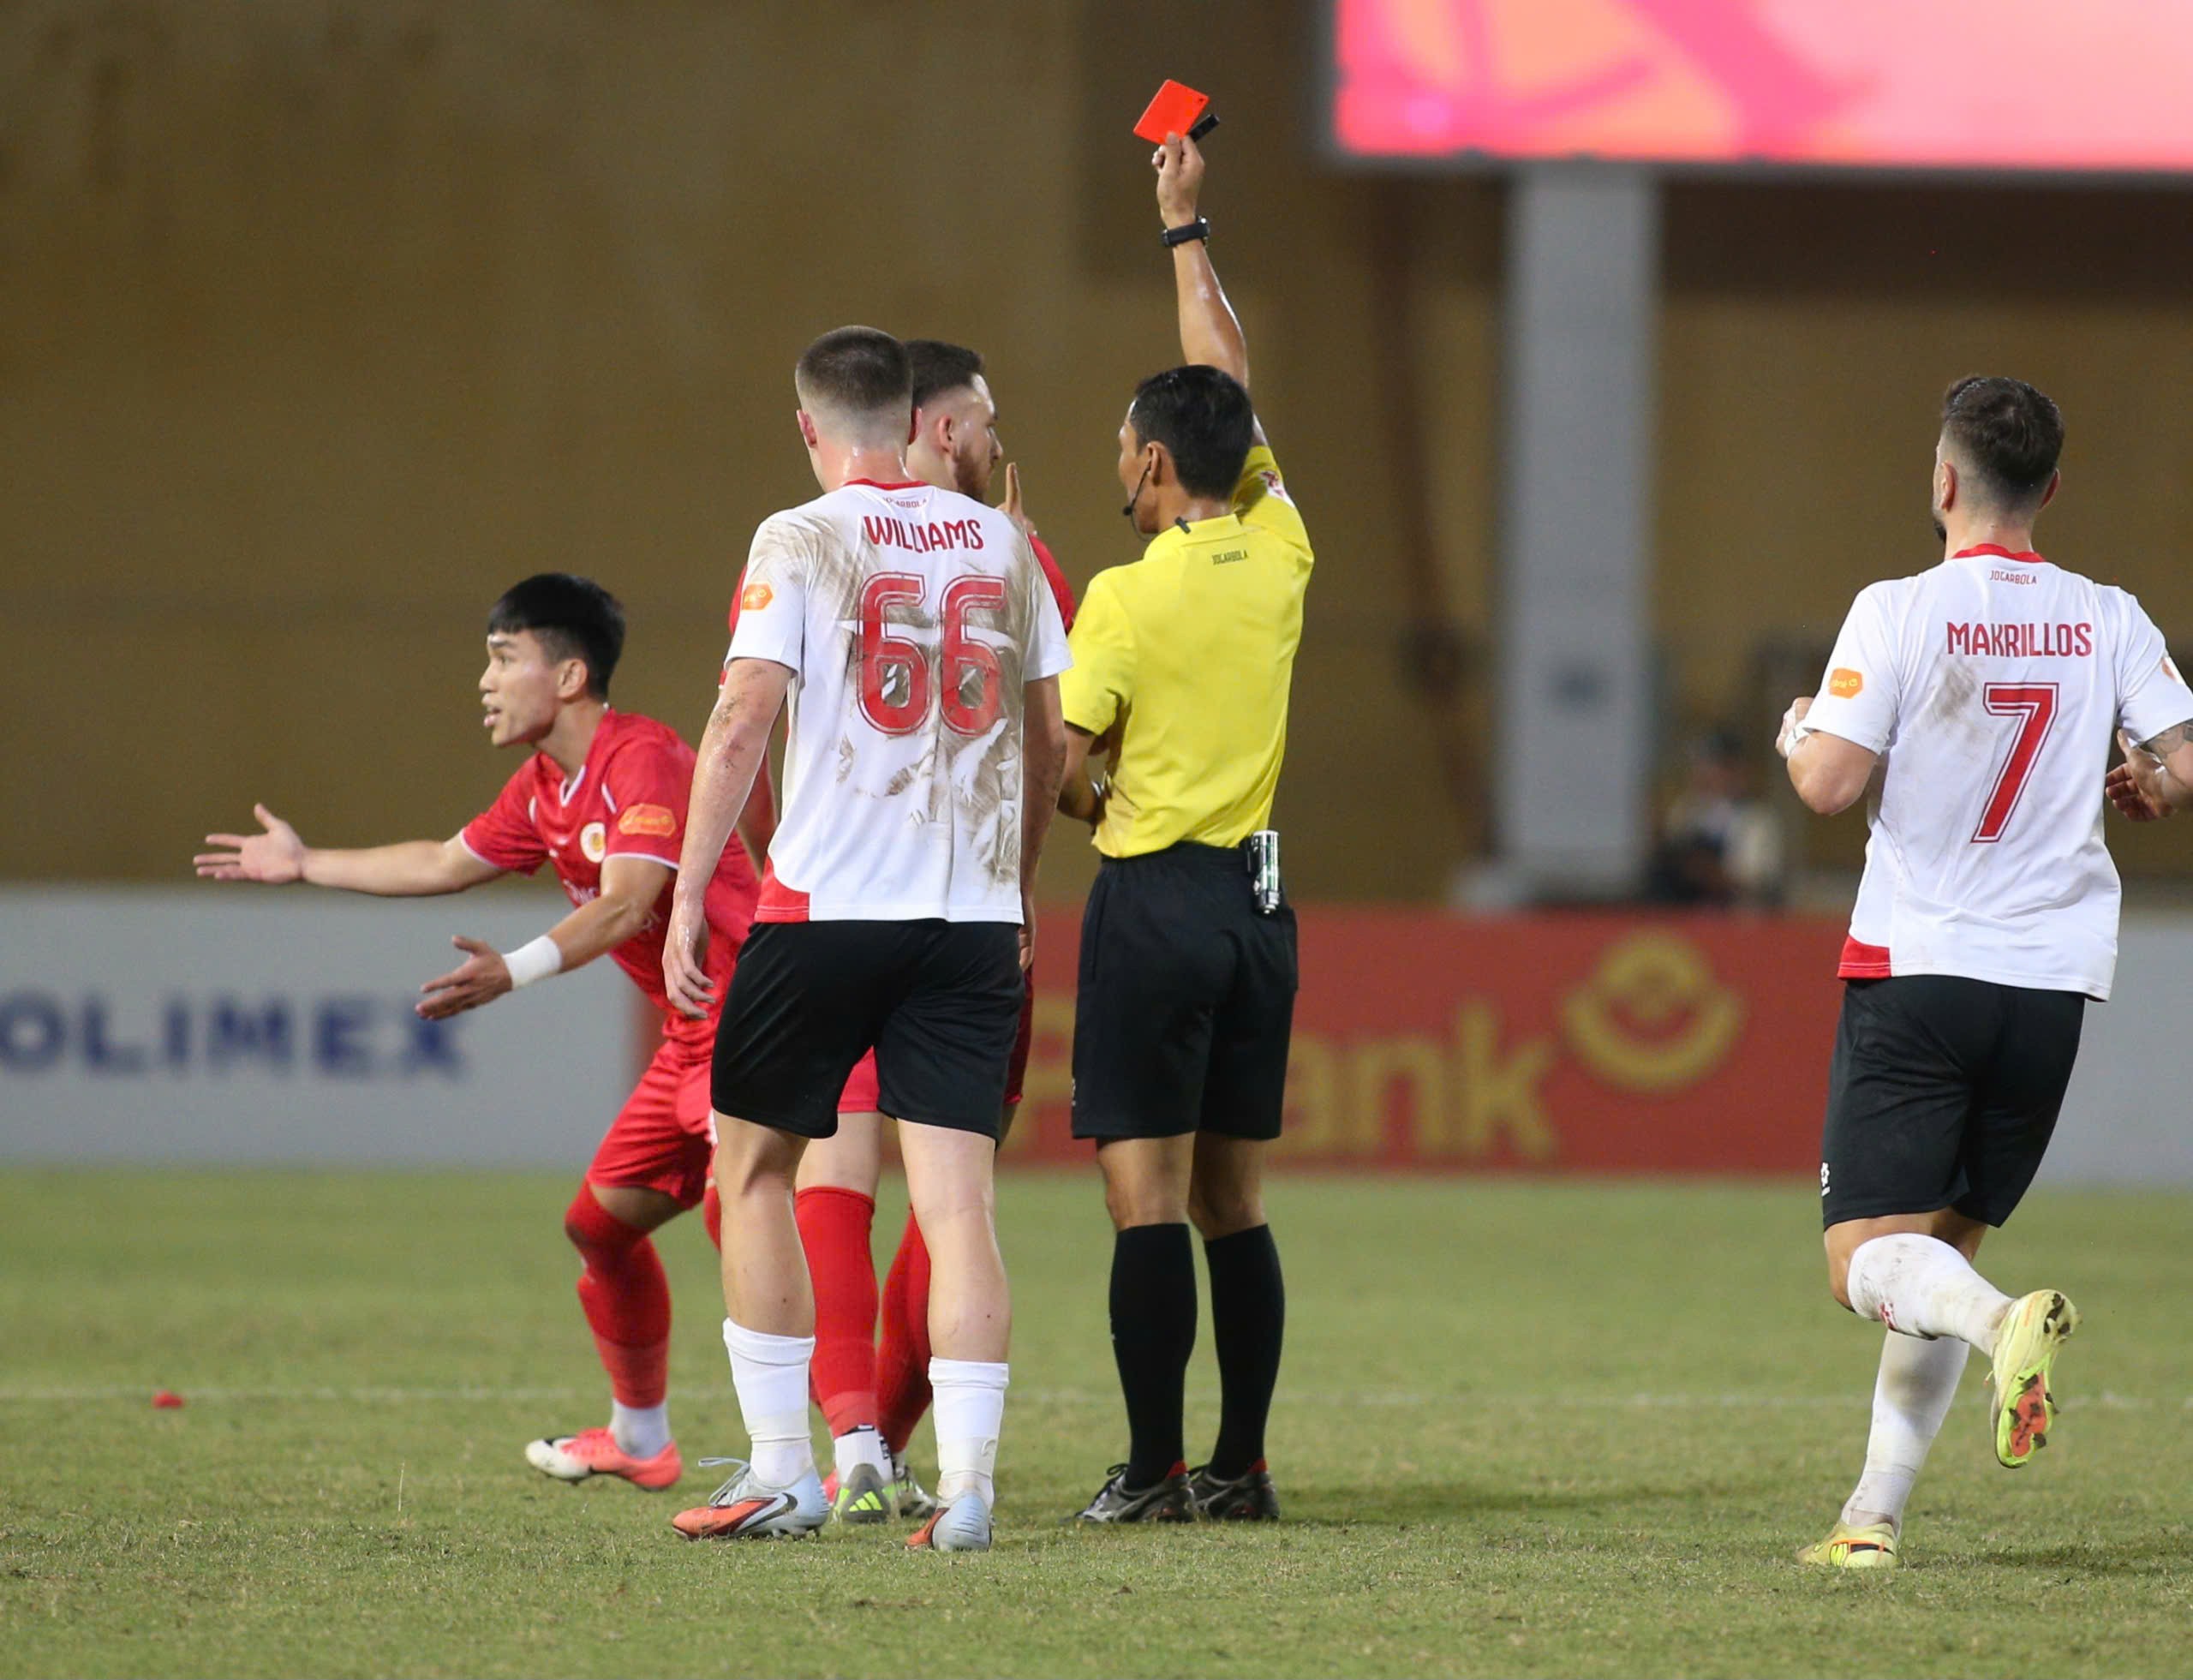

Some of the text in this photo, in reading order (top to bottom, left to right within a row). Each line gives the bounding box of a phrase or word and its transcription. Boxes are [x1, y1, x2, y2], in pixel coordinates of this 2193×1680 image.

[863, 516, 983, 553] WILLIAMS
[857, 571, 1007, 736] 66
[1946, 622, 2092, 658] MAKRILLOS
[1971, 682, 2059, 844] 7
[0, 993, 467, 1078] OLIMEX
